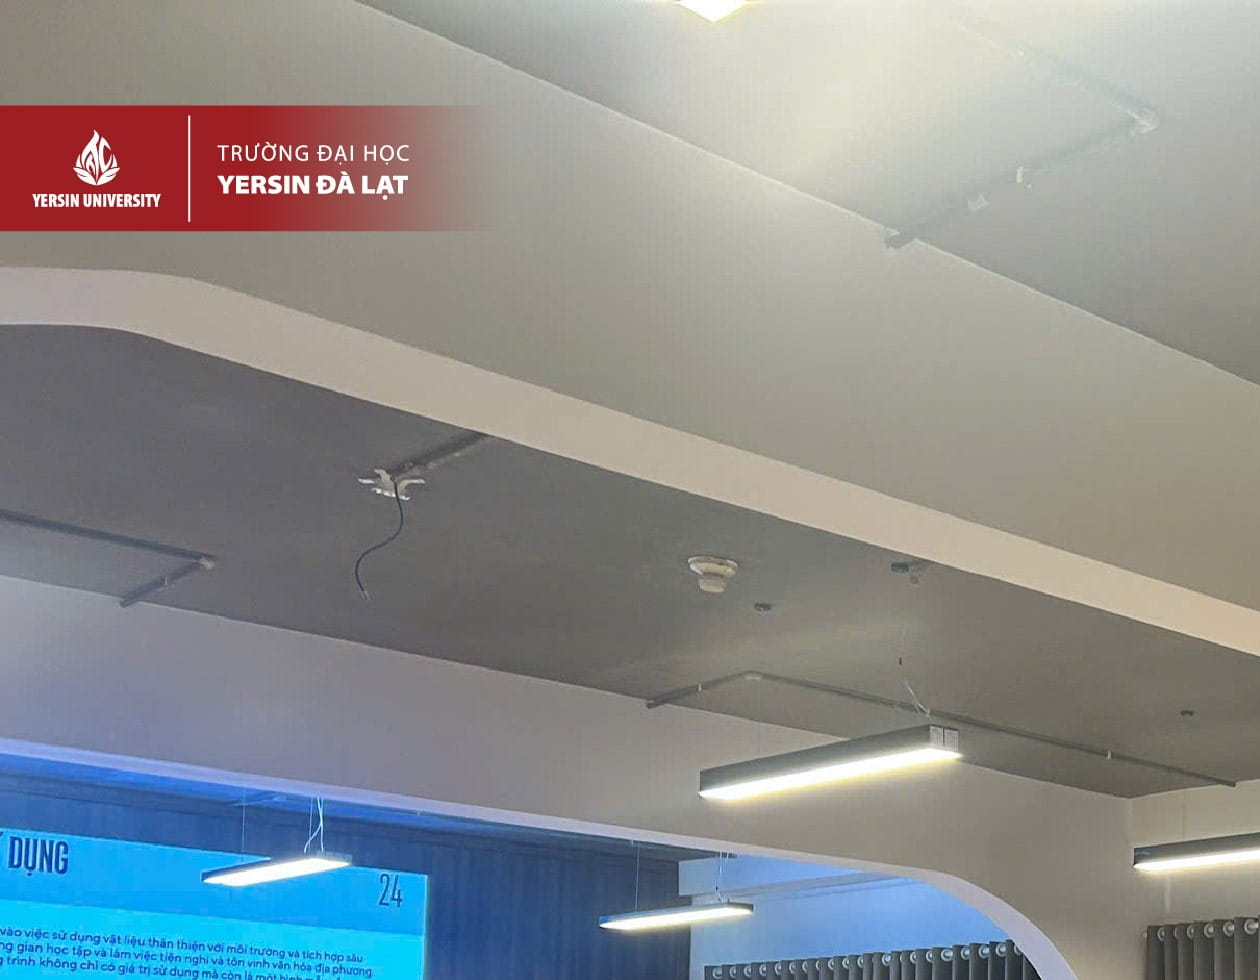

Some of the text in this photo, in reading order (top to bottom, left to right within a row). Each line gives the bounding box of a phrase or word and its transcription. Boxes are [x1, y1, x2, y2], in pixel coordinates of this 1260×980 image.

[8, 836, 69, 877] DỤNG
[379, 873, 403, 907] 24
[17, 940, 43, 954] gian
[47, 942, 69, 956] học
[72, 945, 92, 958] tập
[94, 947, 107, 958] và
[110, 948, 131, 958] làm
[134, 950, 157, 962] việc
[184, 955, 209, 966] nghi
[211, 956, 224, 966] và
[248, 959, 270, 968] vinh
[294, 961, 312, 971] hóa
[315, 963, 330, 976] địa
[25, 928, 49, 940] việc
[70, 931, 100, 945] dụng
[124, 935, 146, 948] liệu
[207, 942, 224, 953] với
[227, 944, 248, 954] môi
[250, 946, 285, 959] trường
[288, 950, 300, 959] và
[40, 957, 77, 972] không
[101, 962, 116, 971] có
[119, 963, 135, 975] giá
[202, 969, 219, 979] mà
[222, 970, 242, 980] còn
